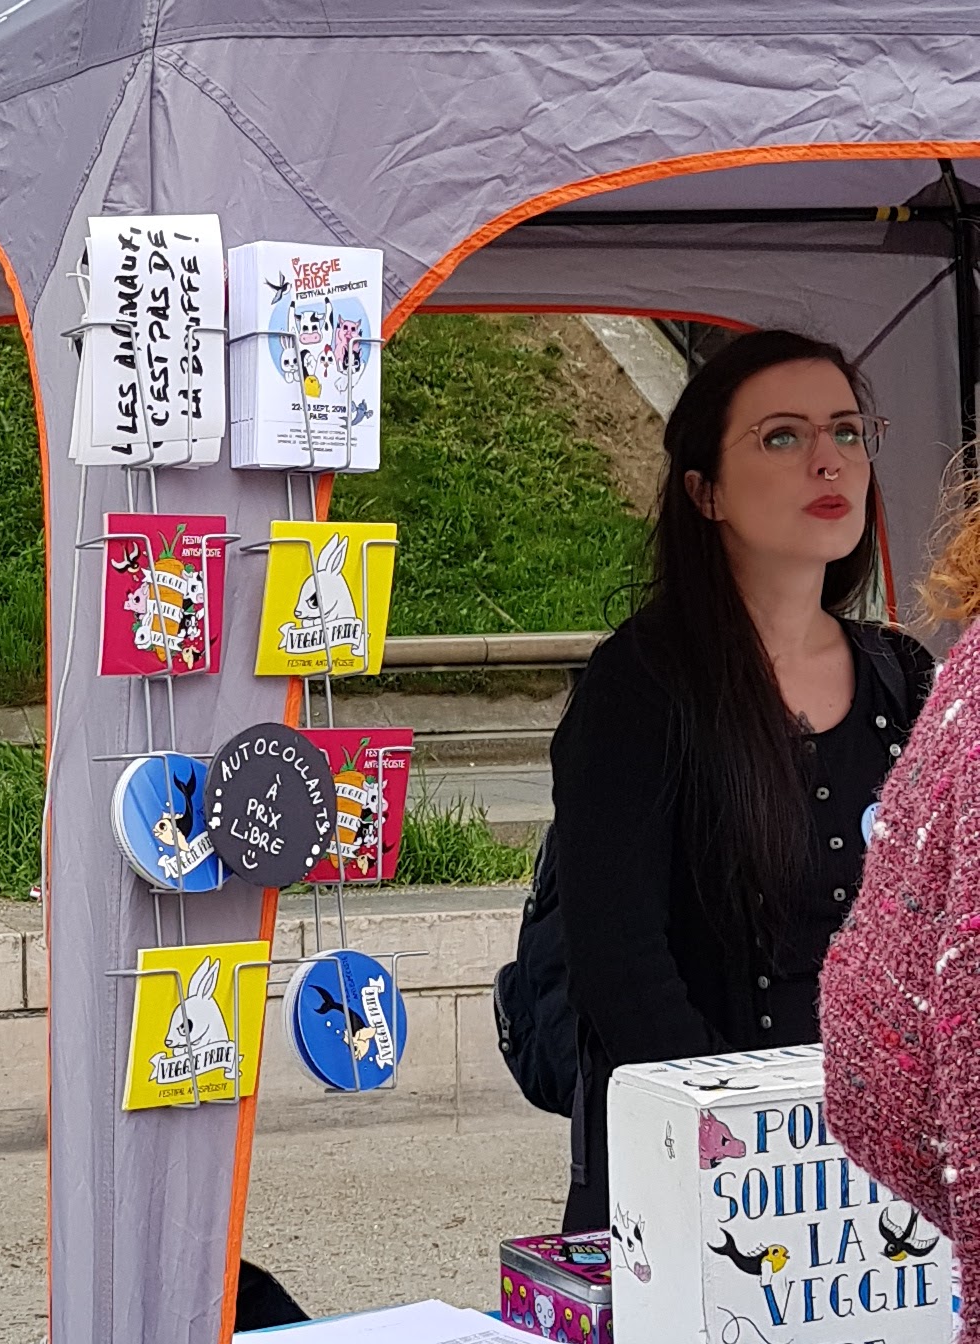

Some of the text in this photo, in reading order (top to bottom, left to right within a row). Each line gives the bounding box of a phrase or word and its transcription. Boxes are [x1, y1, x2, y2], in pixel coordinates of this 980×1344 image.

[292, 258, 341, 278] VEGGIE
[294, 275, 331, 292] PRIDE
[296, 288, 326, 300] FESTIVAL
[146, 230, 175, 426] C'EST PAS DE
[180, 256, 203, 376] BOUFFE
[116, 382, 138, 434] LES
[178, 389, 202, 419] LA
[331, 623, 360, 642] PRIDE
[365, 989, 381, 1017] PRIDE
[204, 1047, 233, 1067] PRIDE
[713, 1157, 901, 1223] SOUTE
[807, 1218, 866, 1268] LA
[762, 1262, 939, 1327] VEGGIE
